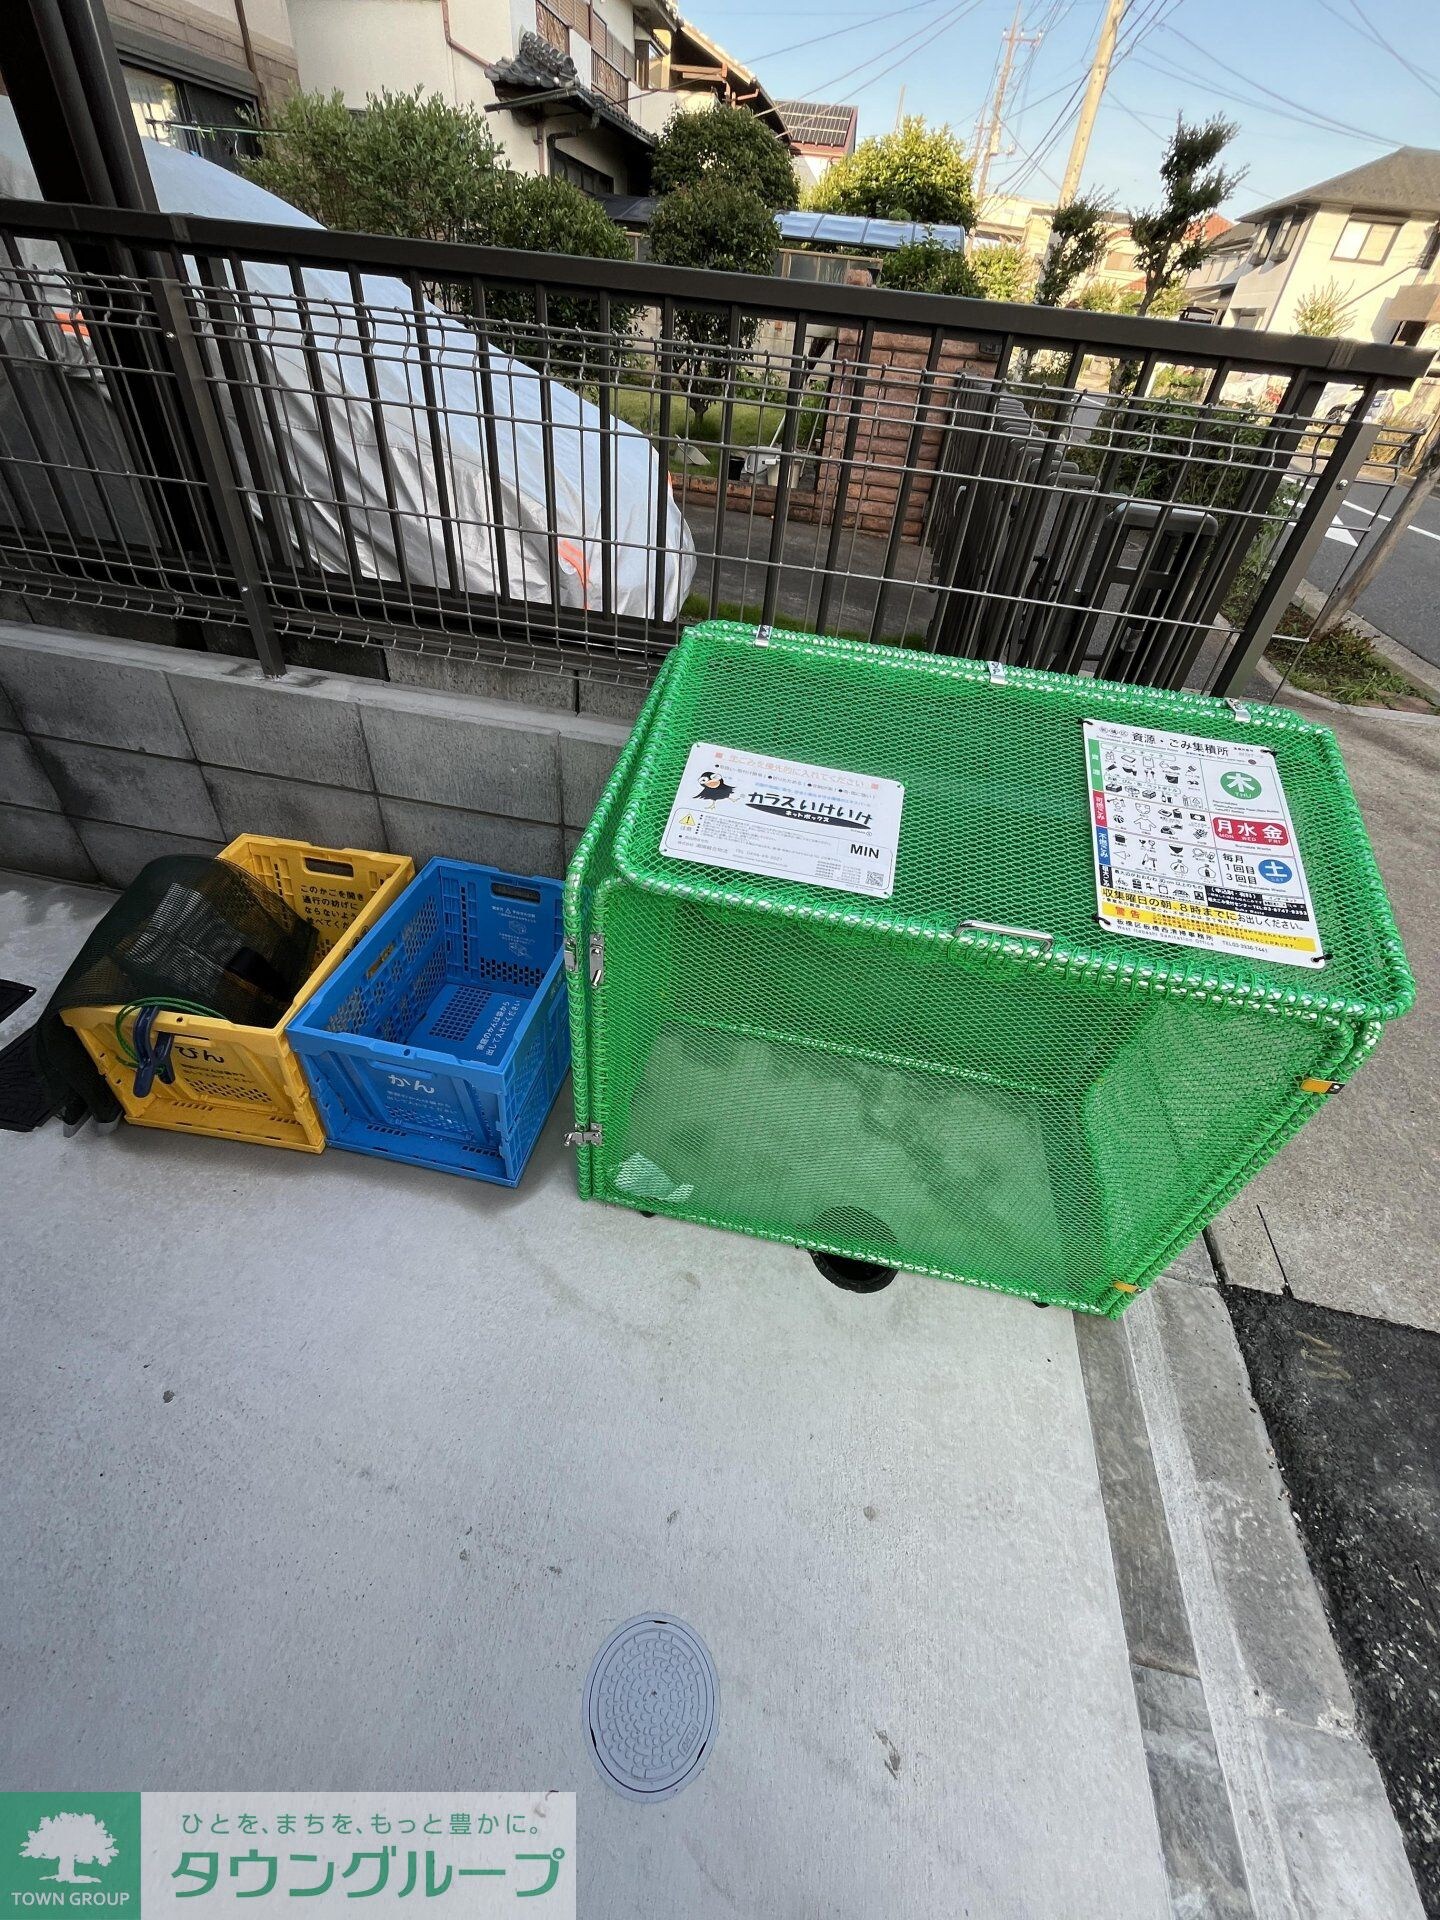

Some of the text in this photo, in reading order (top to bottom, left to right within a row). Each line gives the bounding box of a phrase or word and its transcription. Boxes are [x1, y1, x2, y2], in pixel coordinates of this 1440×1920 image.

[1132, 732, 1229, 757] 資源・ごみ集積所
[1226, 773, 1255, 793] 木
[748, 792, 873, 825] カラスいけいけ
[785, 810, 830, 823] ネットボックス
[1217, 819, 1284, 840] 月 水 金
[850, 843, 880, 859] MIN
[1222, 853, 1244, 863] 毎月
[1225, 864, 1255, 875] 1回目
[1265, 861, 1288, 878] 土
[1226, 873, 1257, 885] 3回目
[174, 1045, 225, 1064] びん
[387, 1074, 435, 1094] かん
